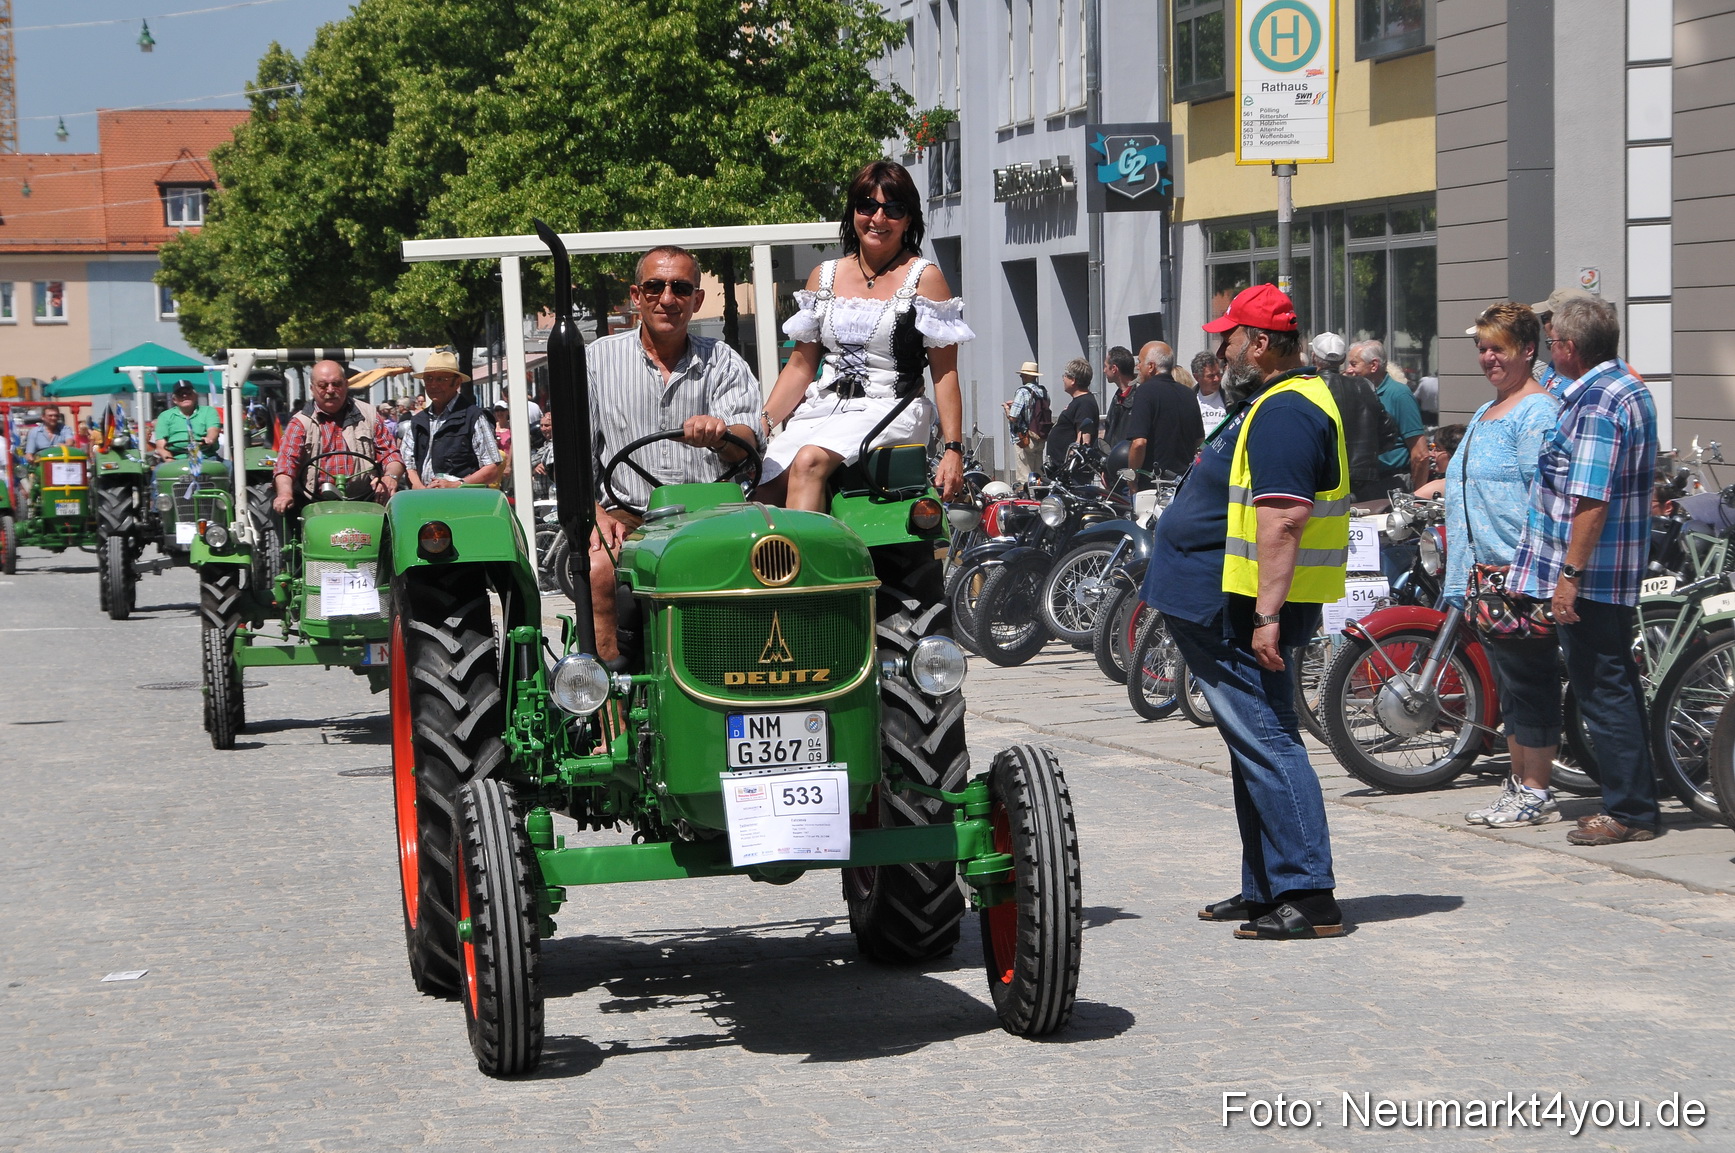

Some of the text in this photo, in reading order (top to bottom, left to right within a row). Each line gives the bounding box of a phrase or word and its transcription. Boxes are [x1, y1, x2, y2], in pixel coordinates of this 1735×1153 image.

[1271, 15, 1299, 56] H
[1261, 82, 1308, 92] Rathaus
[1118, 147, 1147, 184] G2
[349, 579, 368, 590] 114
[1644, 580, 1668, 593] 102
[1352, 589, 1374, 602] 514
[724, 668, 831, 685] DEUTZ
[749, 715, 781, 739] NM
[807, 738, 821, 748] 04
[738, 739, 802, 764] G 367
[808, 752, 822, 761] 09
[782, 786, 823, 806] 533
